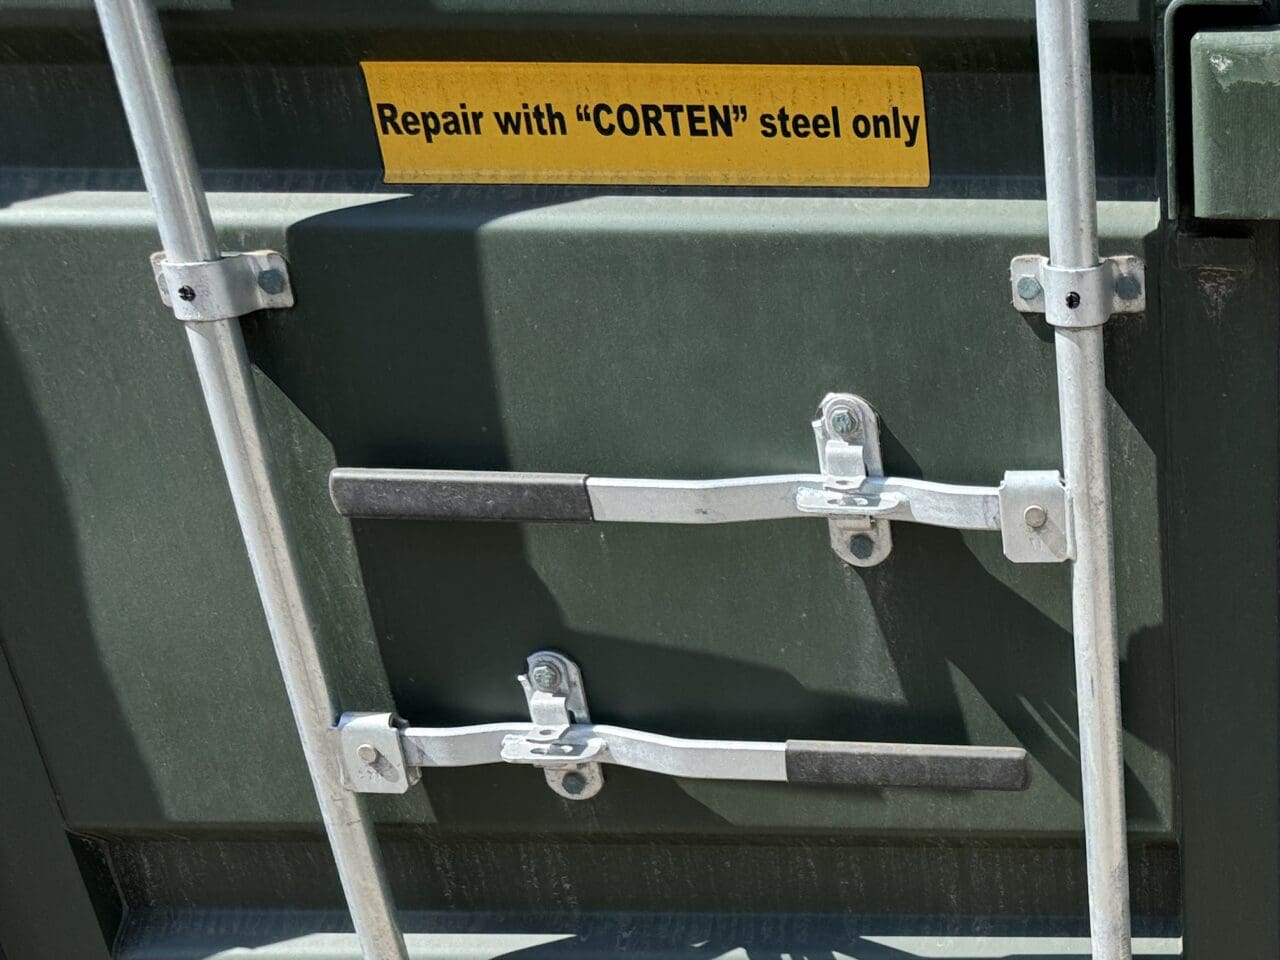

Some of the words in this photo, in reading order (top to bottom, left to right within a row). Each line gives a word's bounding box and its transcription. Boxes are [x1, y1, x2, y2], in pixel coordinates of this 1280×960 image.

[377, 103, 484, 144] Repair
[492, 103, 567, 136] with
[760, 106, 842, 139] steel
[852, 107, 921, 147] only
